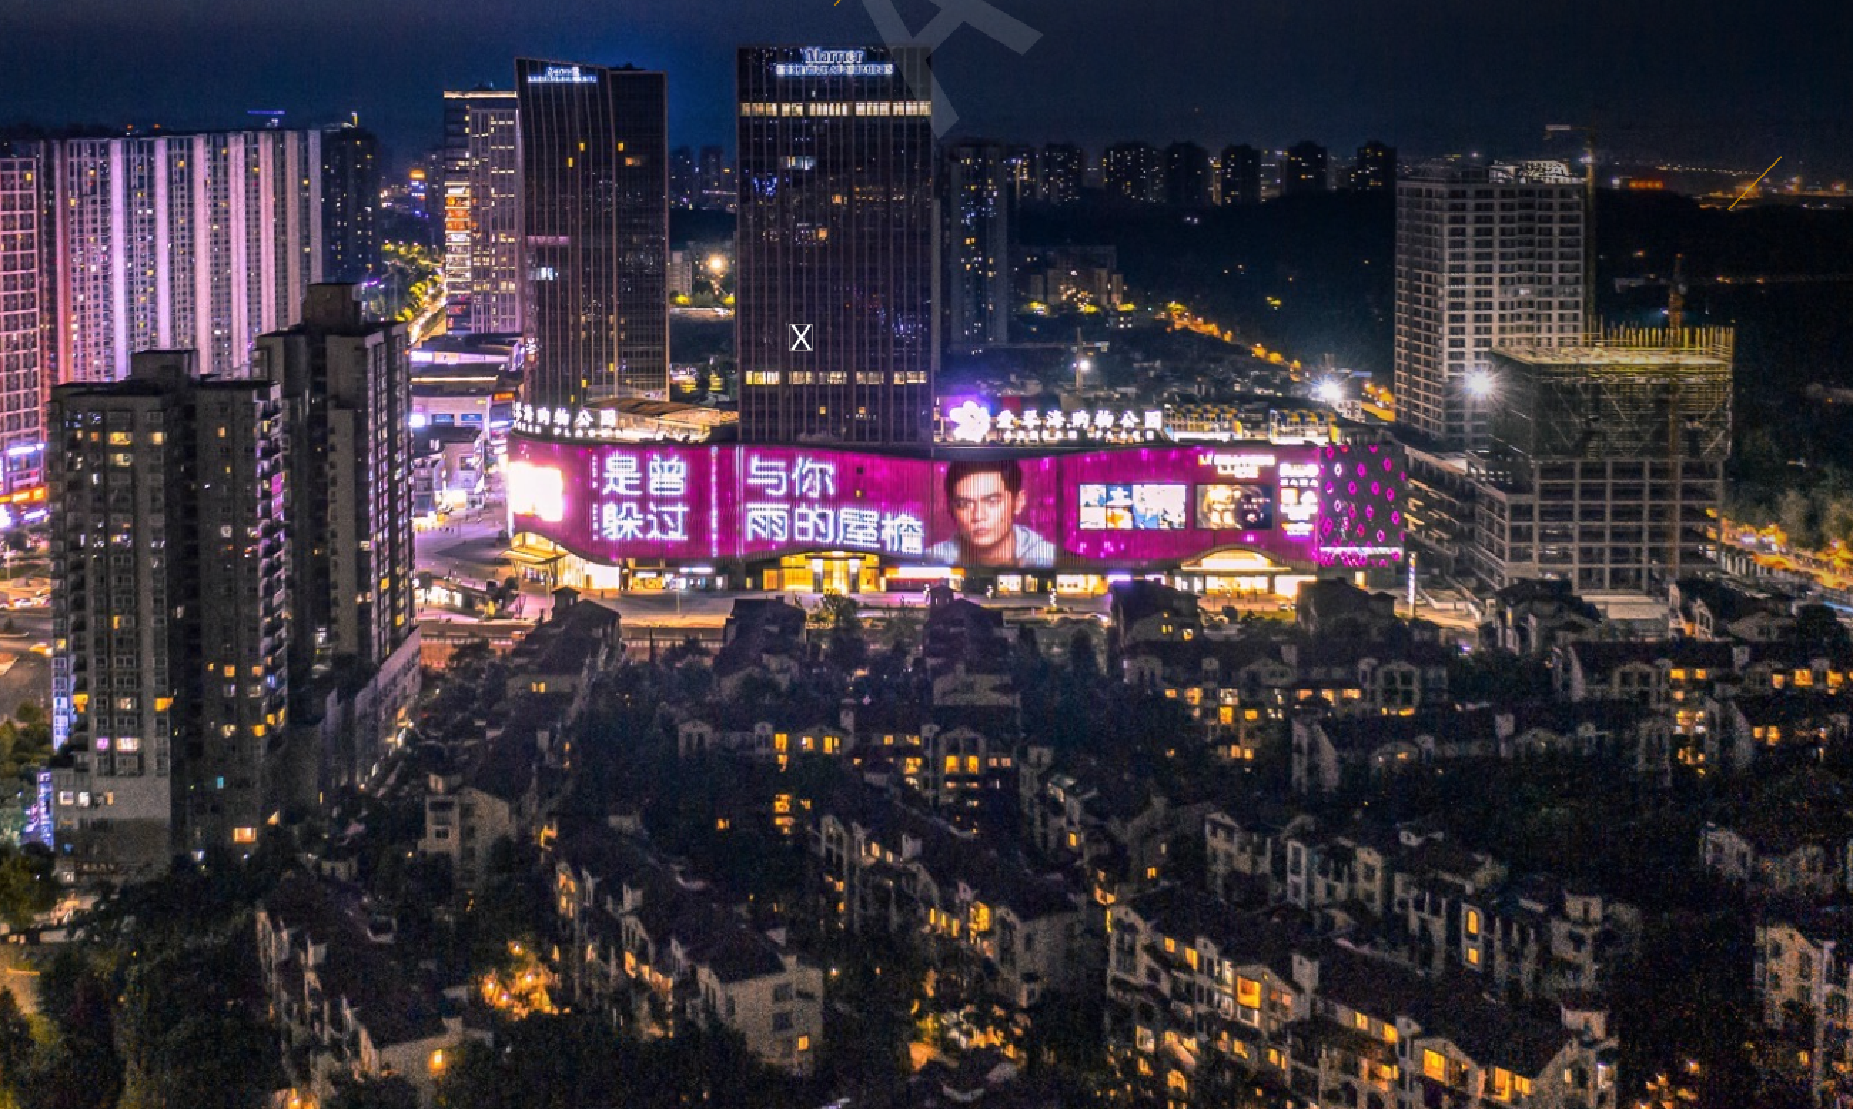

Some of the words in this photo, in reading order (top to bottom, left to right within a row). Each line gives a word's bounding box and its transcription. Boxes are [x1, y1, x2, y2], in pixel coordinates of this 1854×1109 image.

[602, 452, 687, 495] 是曾
[746, 455, 835, 498] 与你
[602, 501, 690, 541] 躲过
[746, 501, 925, 555] 雨的屋檐
